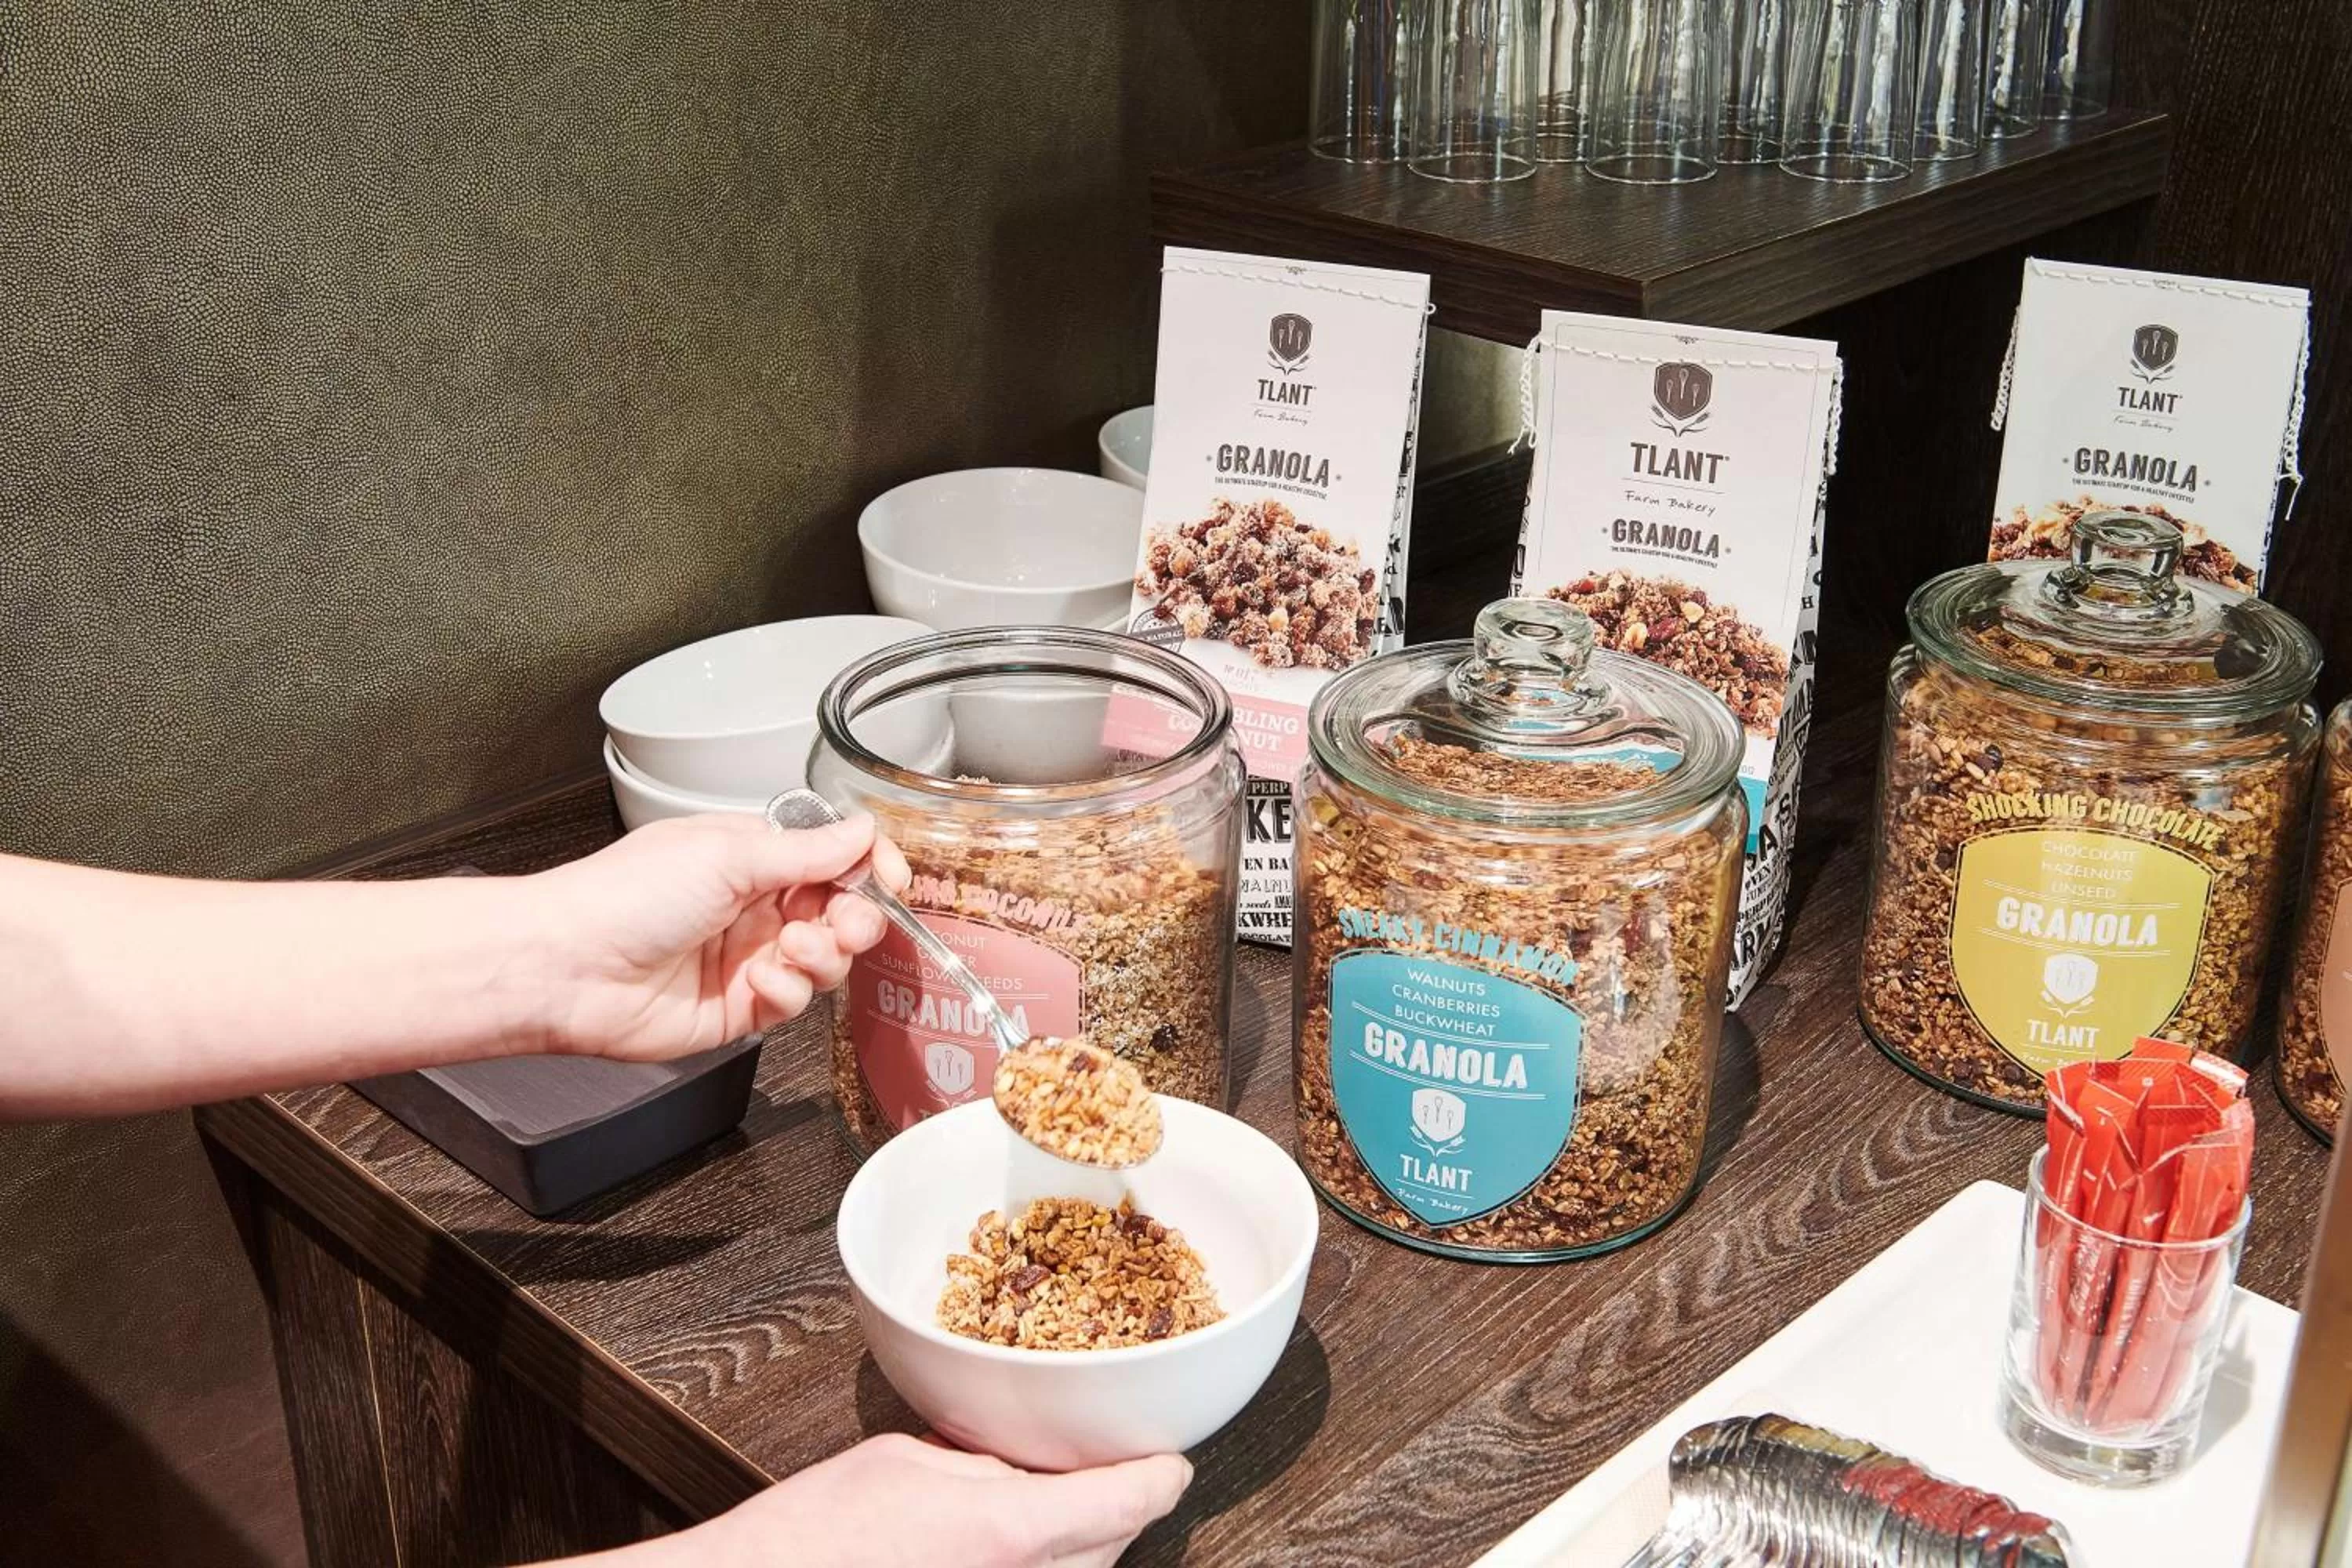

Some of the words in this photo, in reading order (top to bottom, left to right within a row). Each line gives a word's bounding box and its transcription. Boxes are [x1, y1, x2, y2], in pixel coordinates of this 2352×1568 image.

[1258, 379, 1314, 405] TLANT
[2118, 387, 2178, 414] TLANT
[1217, 443, 1330, 488] GRANOLA
[1630, 441, 1724, 484] TLANT
[2074, 447, 2198, 492] GRANOLA
[1624, 490, 1660, 504] Farm
[1667, 497, 1716, 517] Bakery
[1612, 518, 1719, 558] GRANOLA
[1965, 789, 2088, 823] SHOCKING
[2092, 797, 2226, 851] CHOCOLATE
[2041, 840, 2139, 863] CHOCOLATE
[2042, 860, 2134, 882] HAZELNUTS
[1996, 896, 2158, 948] GRANOLA
[1338, 909, 1425, 944] SNEAKY
[1434, 922, 1582, 986] CINNAMON
[1407, 967, 1486, 996] WALNUTS
[877, 979, 1031, 1037] GRANOA
[1392, 983, 1501, 1018] CRANBERRIES
[1394, 1004, 1497, 1037] BUCKWHEAT
[2027, 1019, 2100, 1048] TLANT
[1363, 1022, 1529, 1090] GRANOLA
[1399, 1153, 1473, 1192] TLANT
[1430, 1197, 1470, 1216] Bakery
